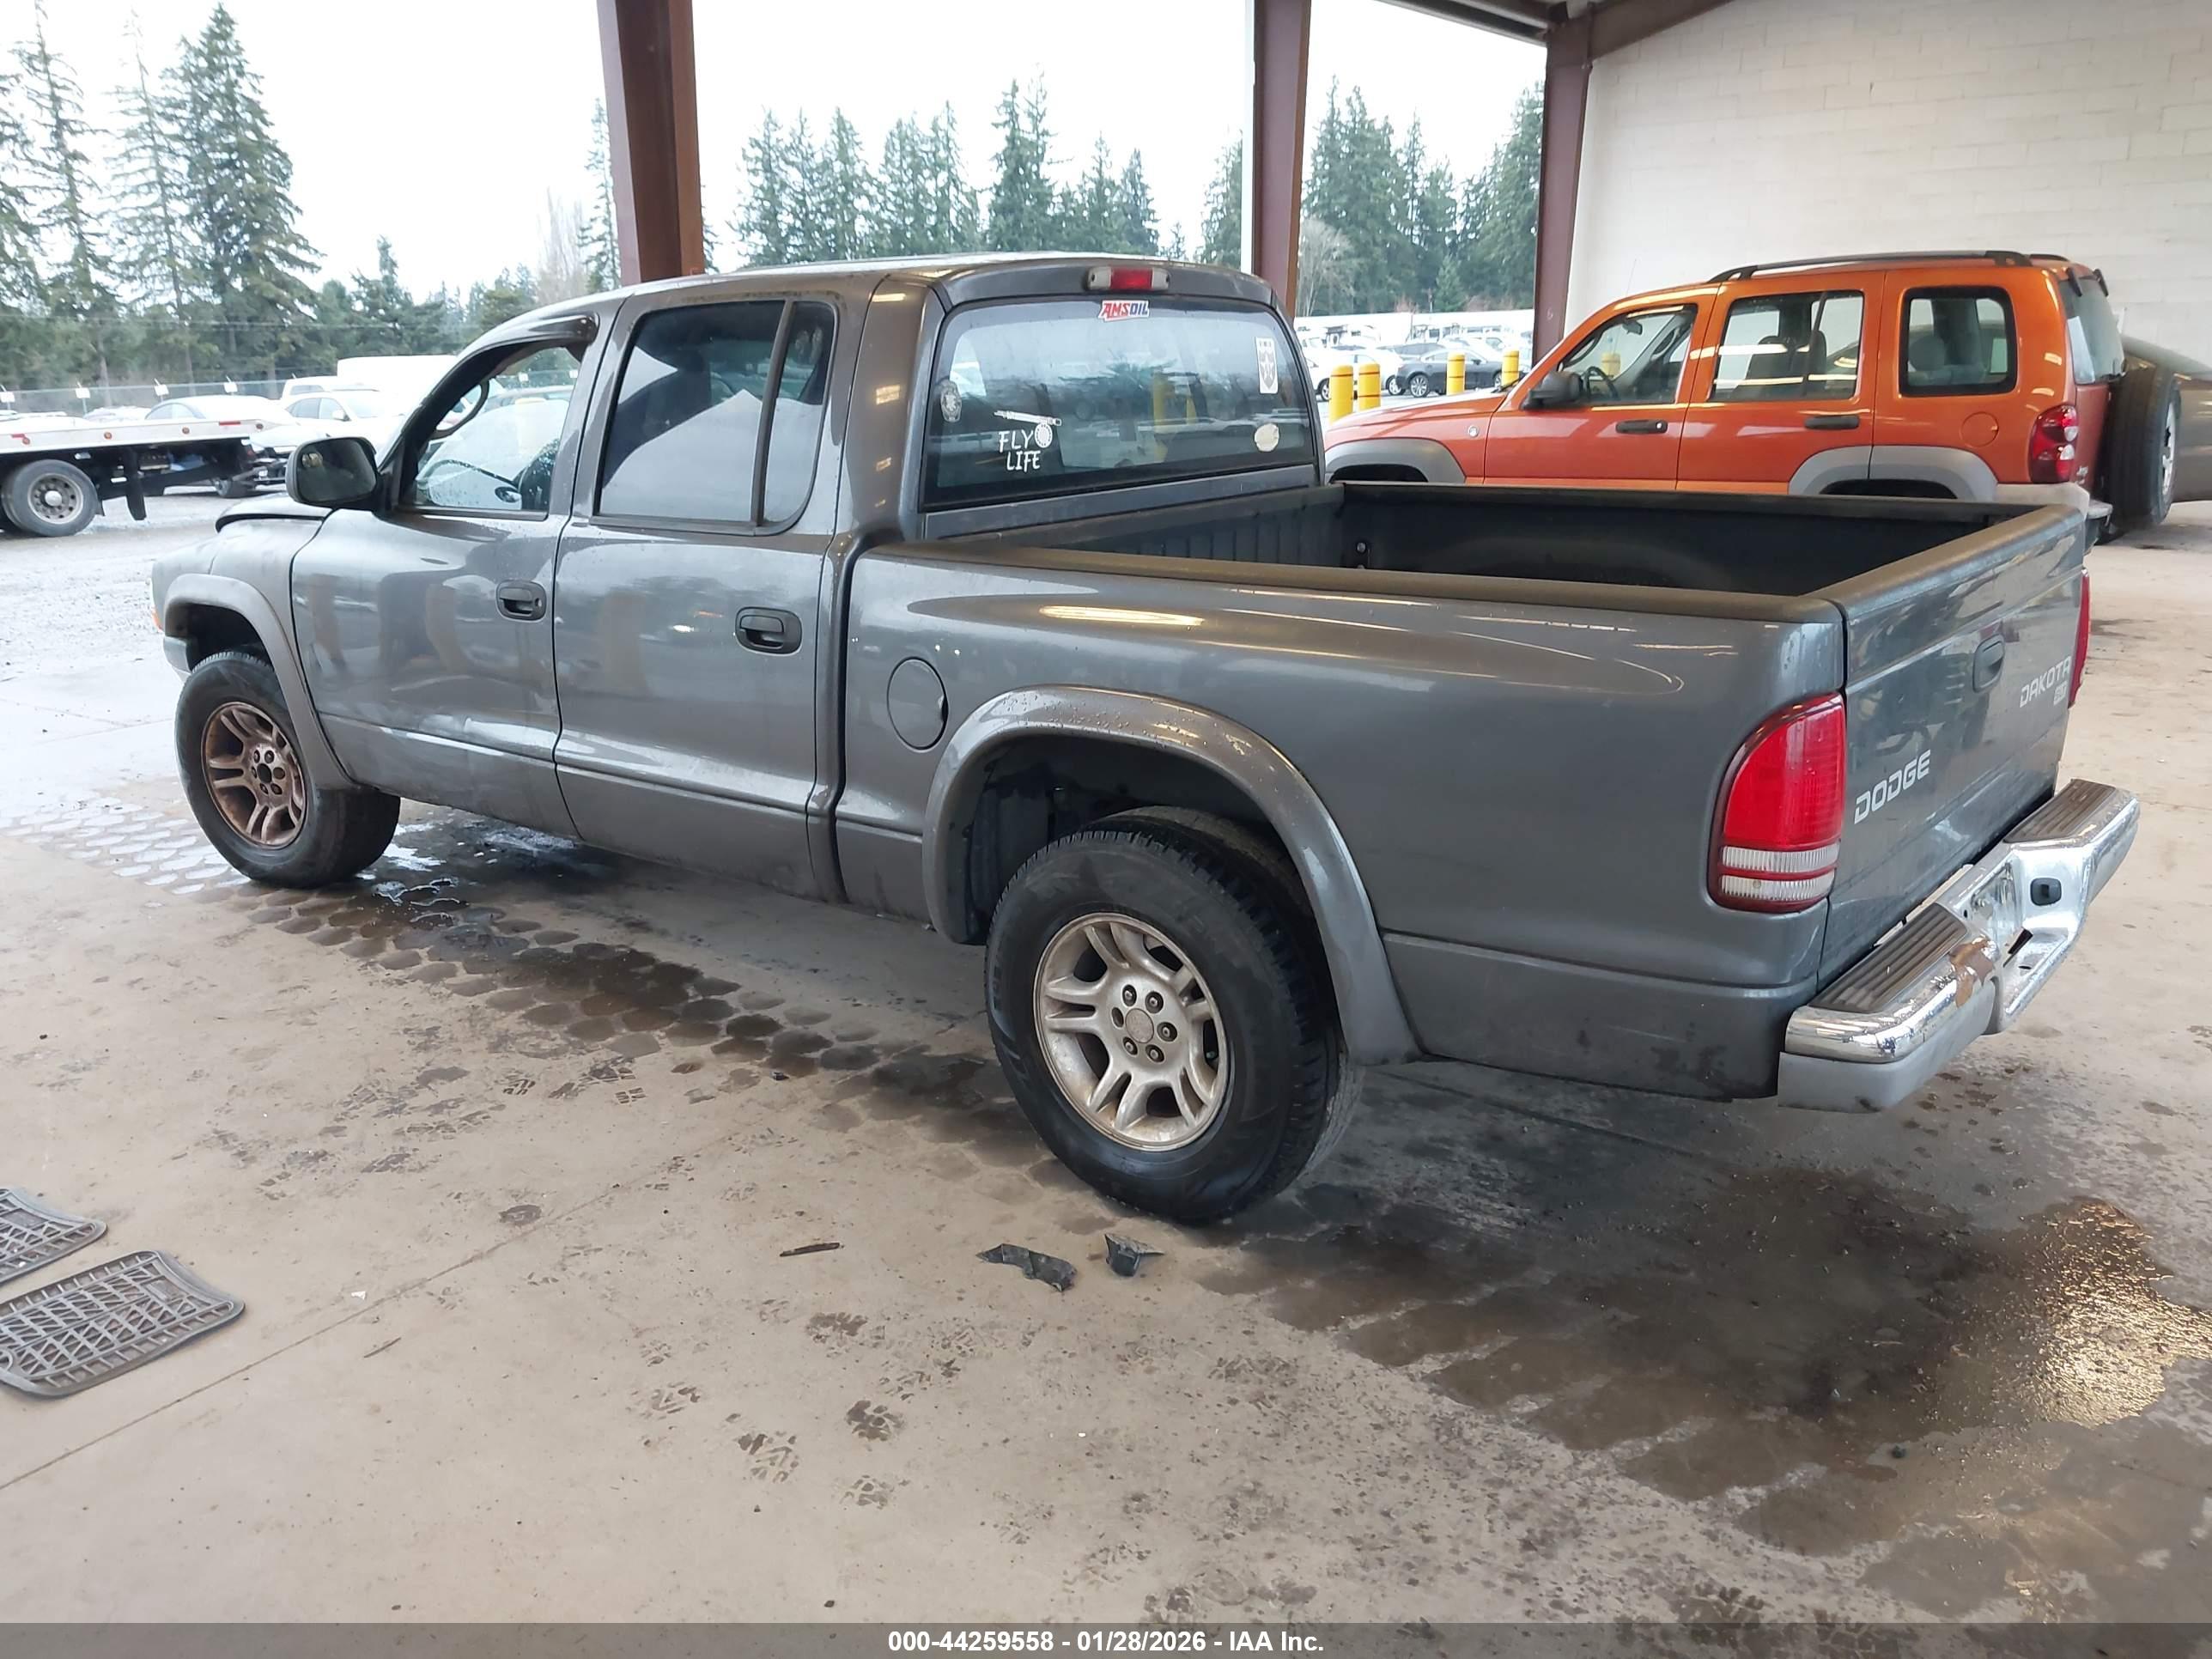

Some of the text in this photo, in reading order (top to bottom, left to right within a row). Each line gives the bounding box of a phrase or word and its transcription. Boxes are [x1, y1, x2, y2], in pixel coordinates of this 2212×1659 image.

[1100, 301, 1149, 319] AMSOIL
[998, 428, 1034, 453] FLY
[1006, 449, 1042, 473] LIFE
[2019, 655, 2072, 708] DAKOTA
[1854, 749, 1931, 824] DODGE
